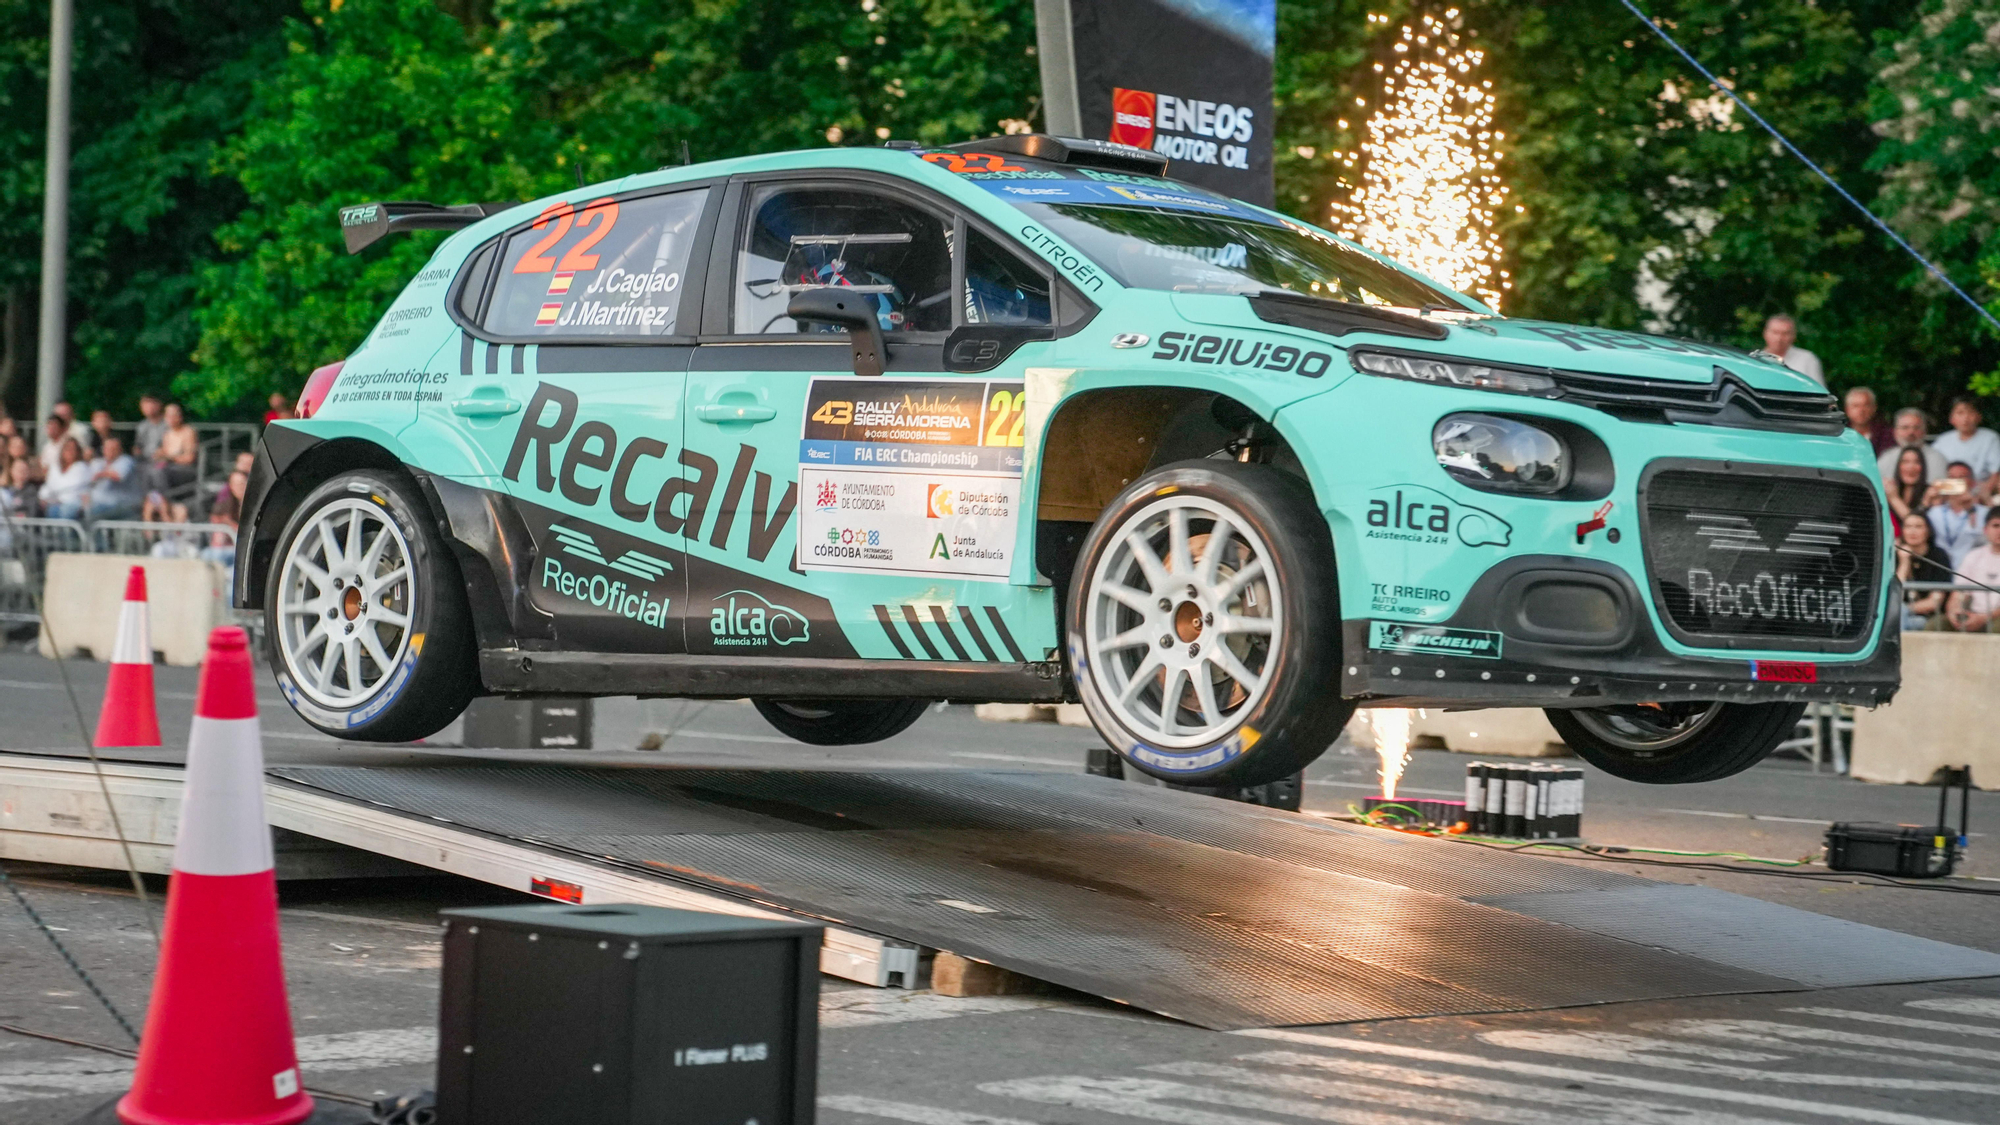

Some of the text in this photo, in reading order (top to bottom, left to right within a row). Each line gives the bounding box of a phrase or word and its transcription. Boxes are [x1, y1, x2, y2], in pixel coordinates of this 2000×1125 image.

[1115, 111, 1152, 129] ENEOS
[1156, 94, 1254, 143] ENEOS
[1098, 147, 1146, 160] RACING TEAM
[1153, 134, 1249, 170] MOTOR OIL
[922, 153, 1026, 173] 22
[342, 206, 378, 221] TRS
[512, 197, 620, 274] 22
[1021, 225, 1104, 292] CITROËN
[413, 268, 451, 283] MARINA
[587, 267, 680, 299] J.Cagiao
[386, 306, 433, 323] TORREIRO
[558, 300, 670, 327] J.Martínez
[951, 339, 1000, 363] C3
[339, 368, 449, 389] integralmotion.es
[349, 391, 380, 402] CENTROS
[381, 391, 392, 401] EN
[393, 391, 412, 401] TODA
[414, 389, 443, 402] ESPAÑA
[811, 400, 853, 425] 43
[855, 394, 964, 416] RALLY Andalucía
[889, 429, 927, 440] CÓRDOBA
[854, 447, 979, 468] FIA ERC Championship
[502, 380, 808, 577] Recalv
[842, 483, 895, 497] AYUNTAMIENTO
[959, 491, 1009, 505] Diputación
[841, 496, 886, 511] DE CÓRDOBA
[958, 504, 1009, 517] de Córdoba
[1367, 490, 1450, 533] alca
[953, 535, 976, 546] Junta
[1366, 530, 1449, 545] Asistencia 24 H
[814, 543, 862, 559] CÓRDOBA
[953, 547, 1004, 560] de Andalucía
[542, 557, 670, 629] RecOficial
[1372, 596, 1398, 605] AUTO
[1688, 567, 1852, 625] RecOficial
[710, 596, 766, 635] alca
[713, 637, 768, 646] Asistencia 24 H
[1407, 634, 1492, 650] MICHELIN
